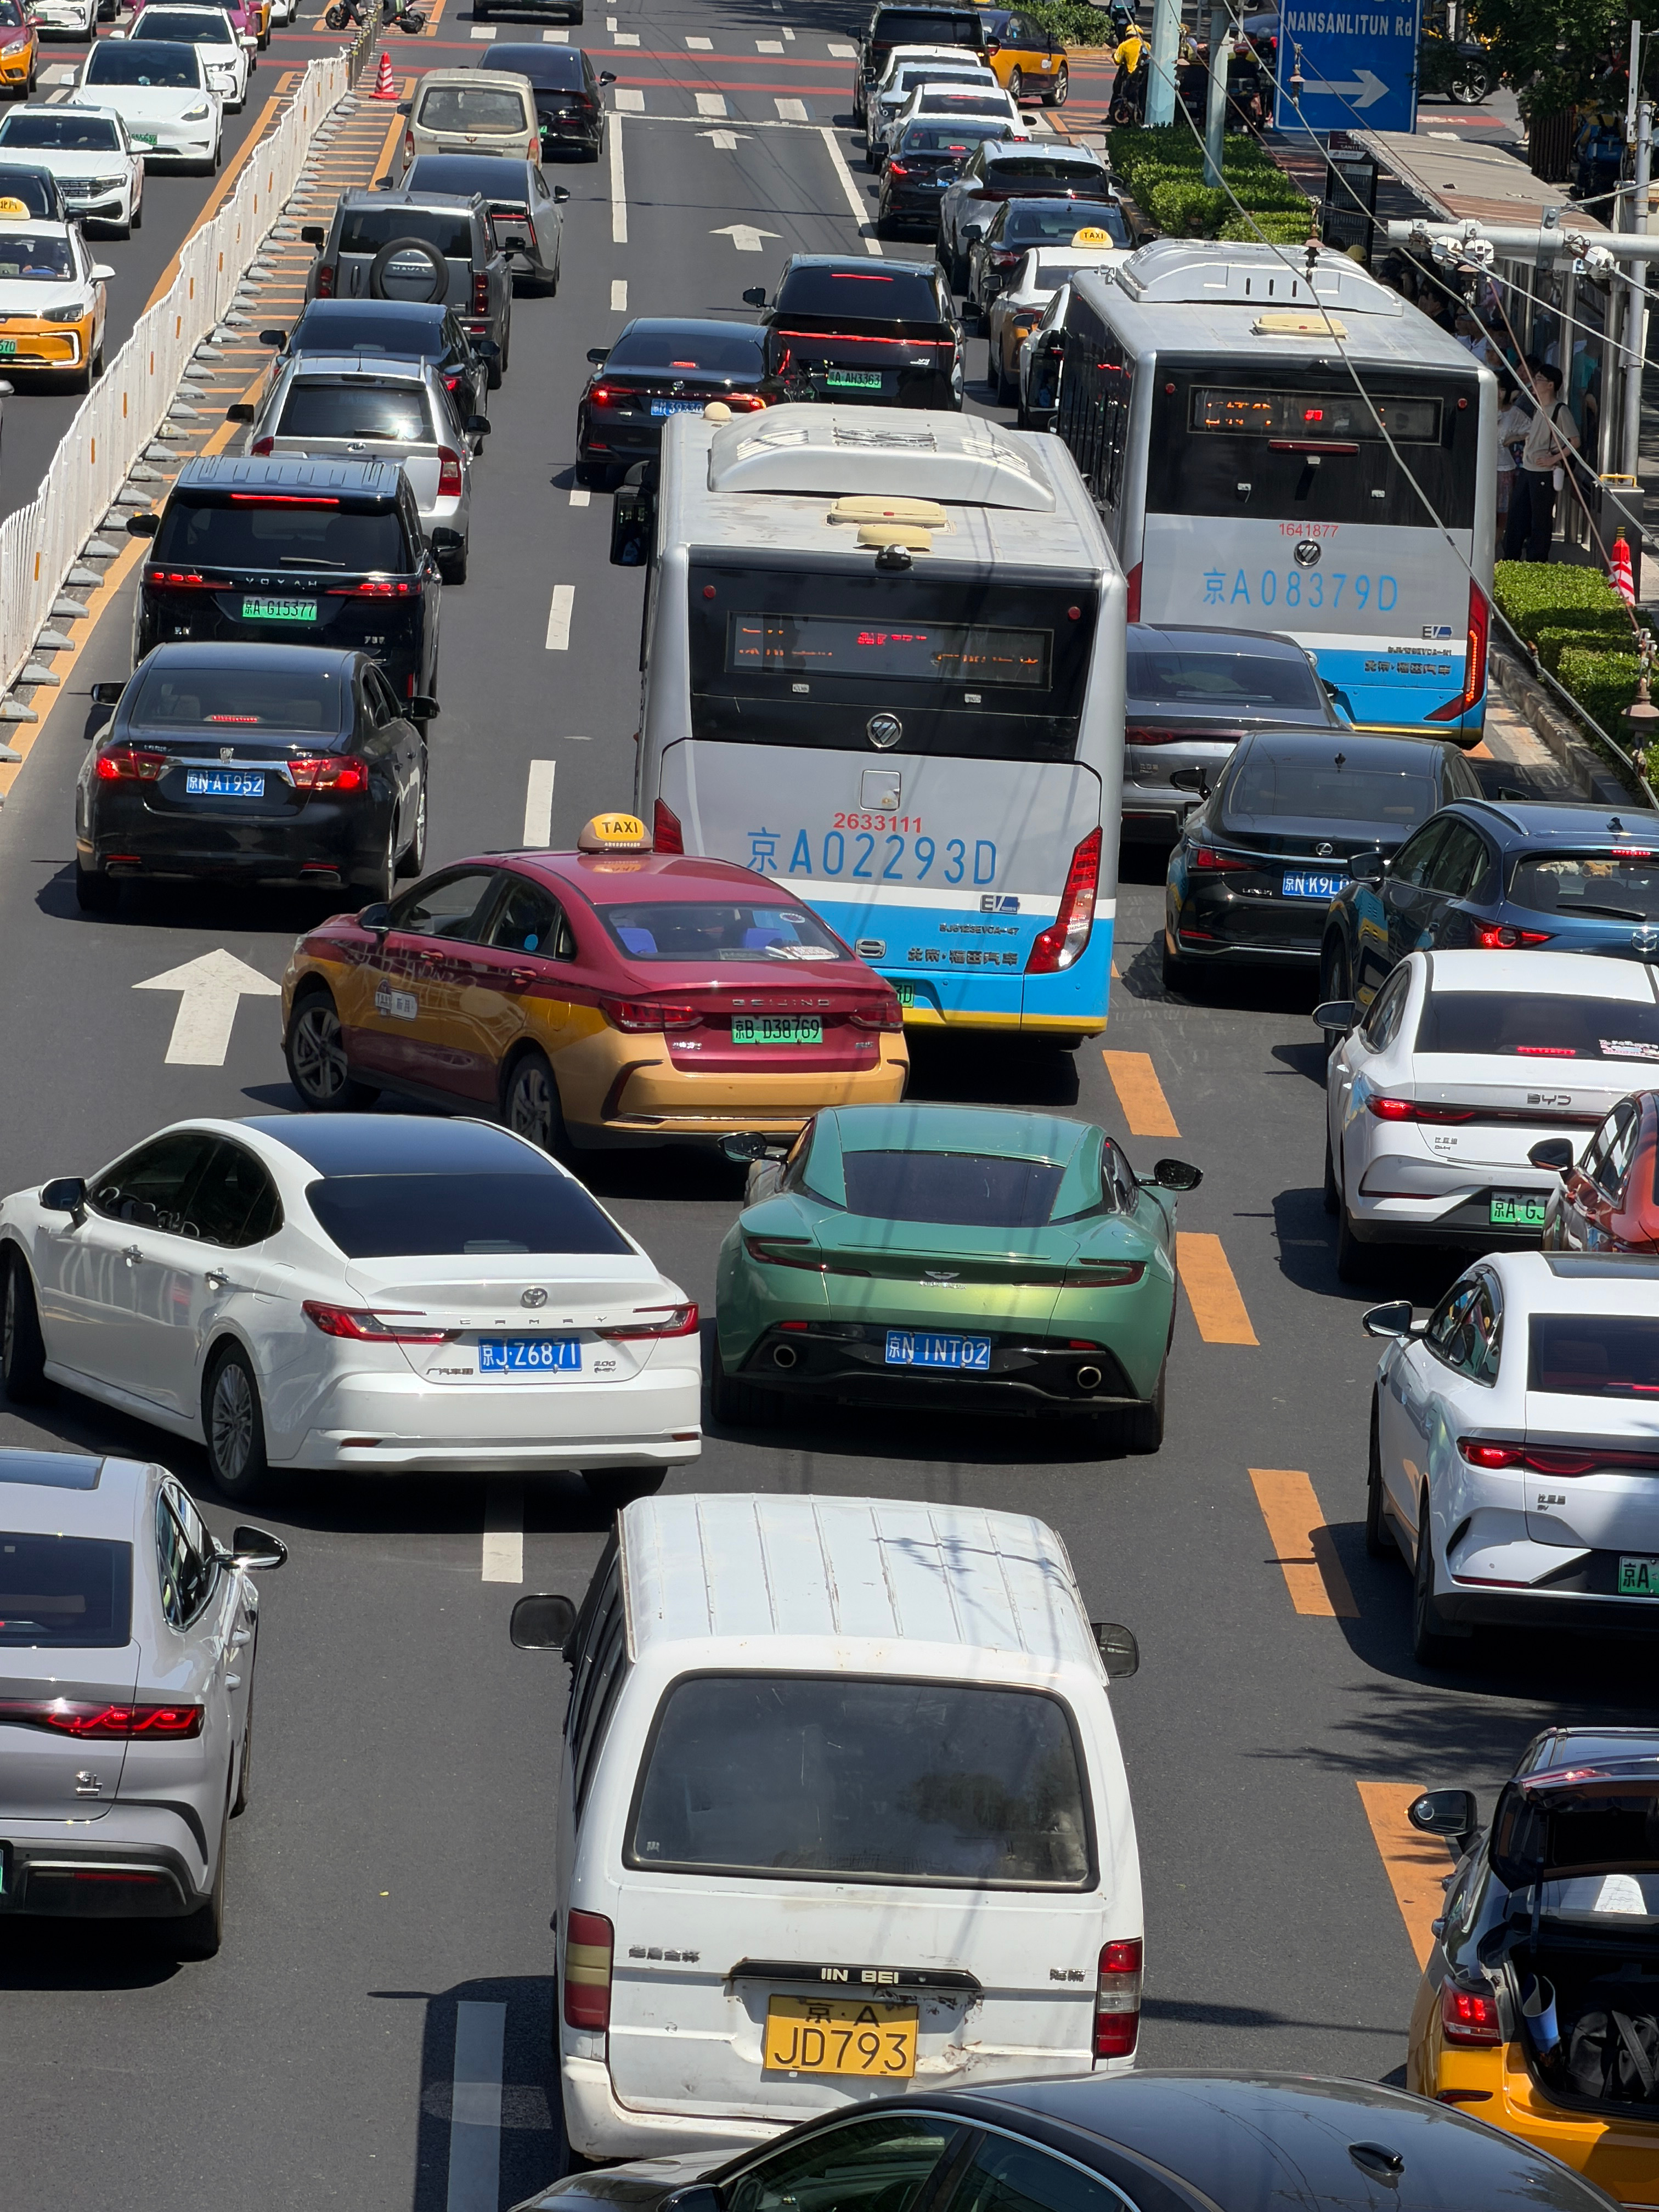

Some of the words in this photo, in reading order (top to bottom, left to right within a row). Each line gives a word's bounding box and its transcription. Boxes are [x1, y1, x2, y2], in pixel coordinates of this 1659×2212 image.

[1287, 11, 1389, 36] NANSANLITUN
[1395, 16, 1412, 37] Rd
[1279, 523, 1339, 537] 1641877
[1203, 567, 1398, 611] 京A08379D
[601, 821, 638, 833] TAXI
[833, 812, 922, 834] 2633111
[747, 826, 997, 885] 京A02293D
[1527, 1093, 1572, 1106] BYD
[482, 1341, 577, 1367] 京J·Z6871
[861, 1970, 899, 1984] BEI
[774, 2027, 908, 2072] JD793
